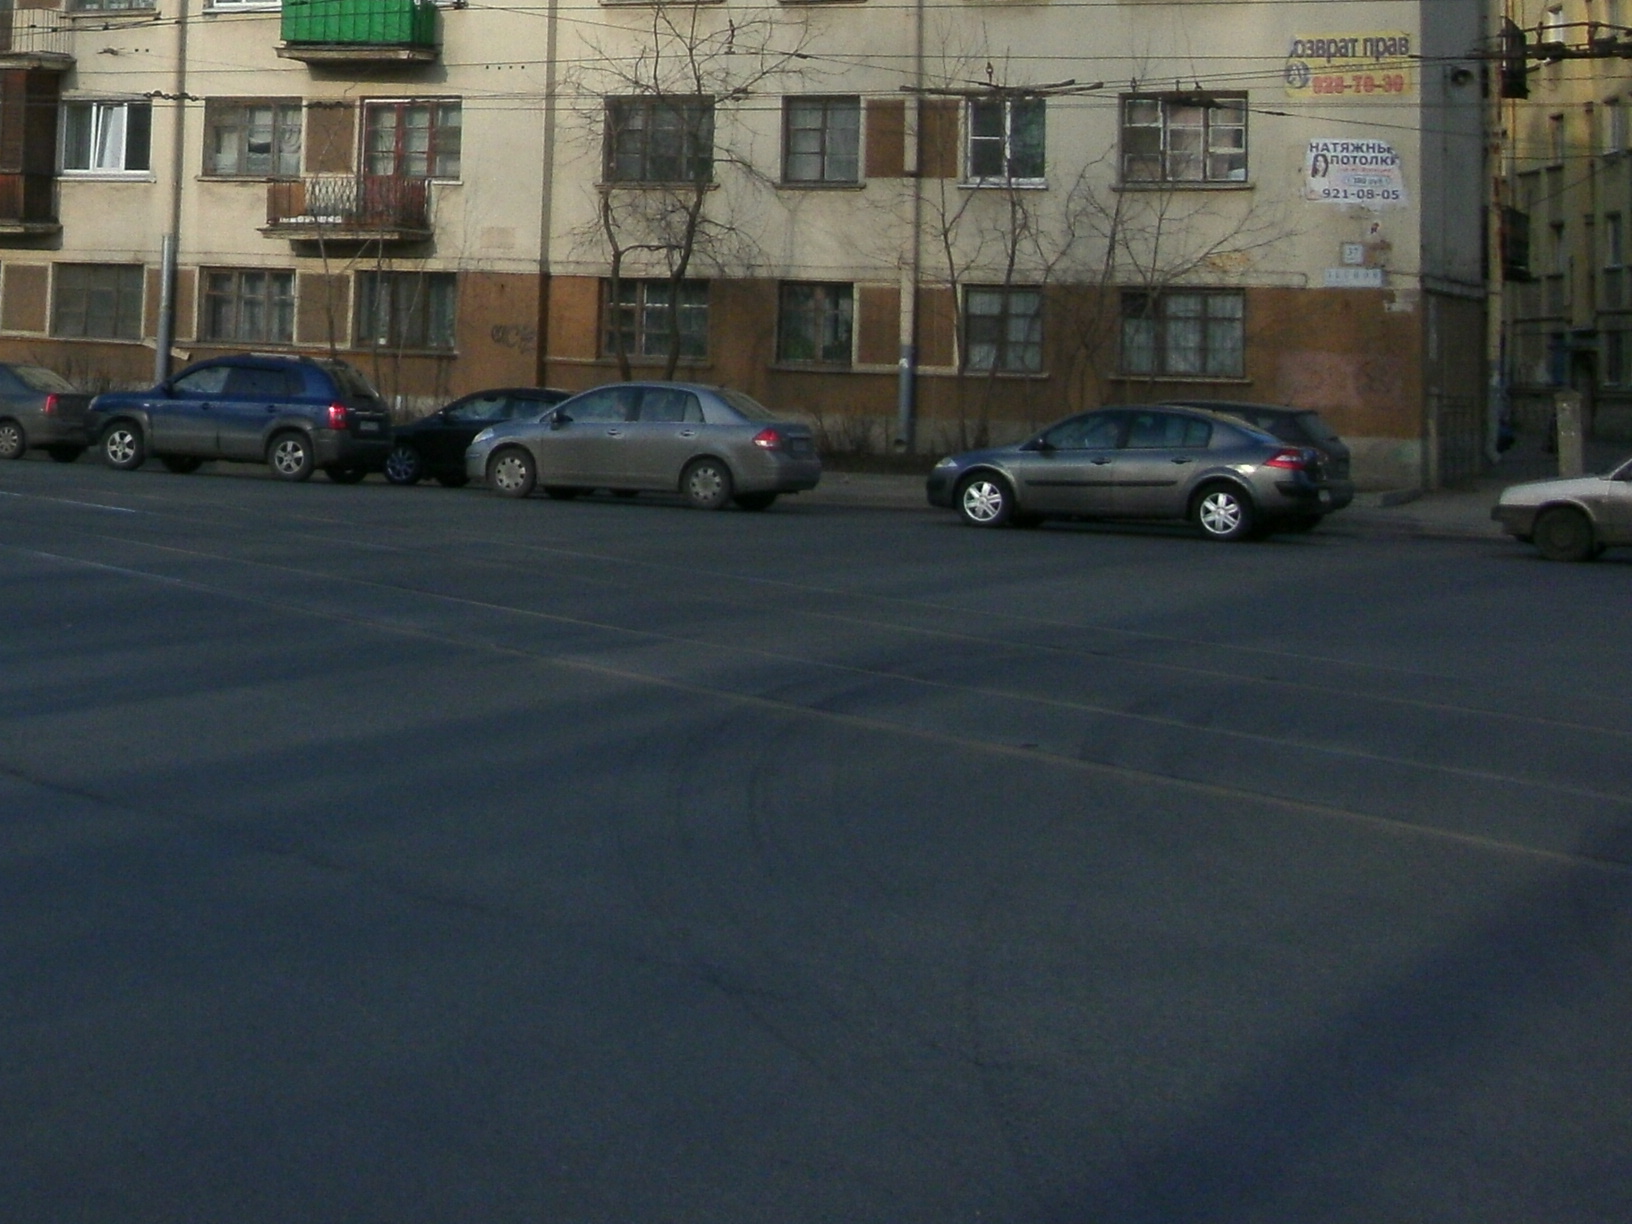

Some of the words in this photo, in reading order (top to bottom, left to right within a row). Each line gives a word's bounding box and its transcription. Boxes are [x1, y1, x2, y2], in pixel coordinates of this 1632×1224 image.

[1291, 38, 1358, 63] озврат
[1363, 36, 1409, 62] прав
[1309, 142, 1395, 155] НАТЯЖНЫ
